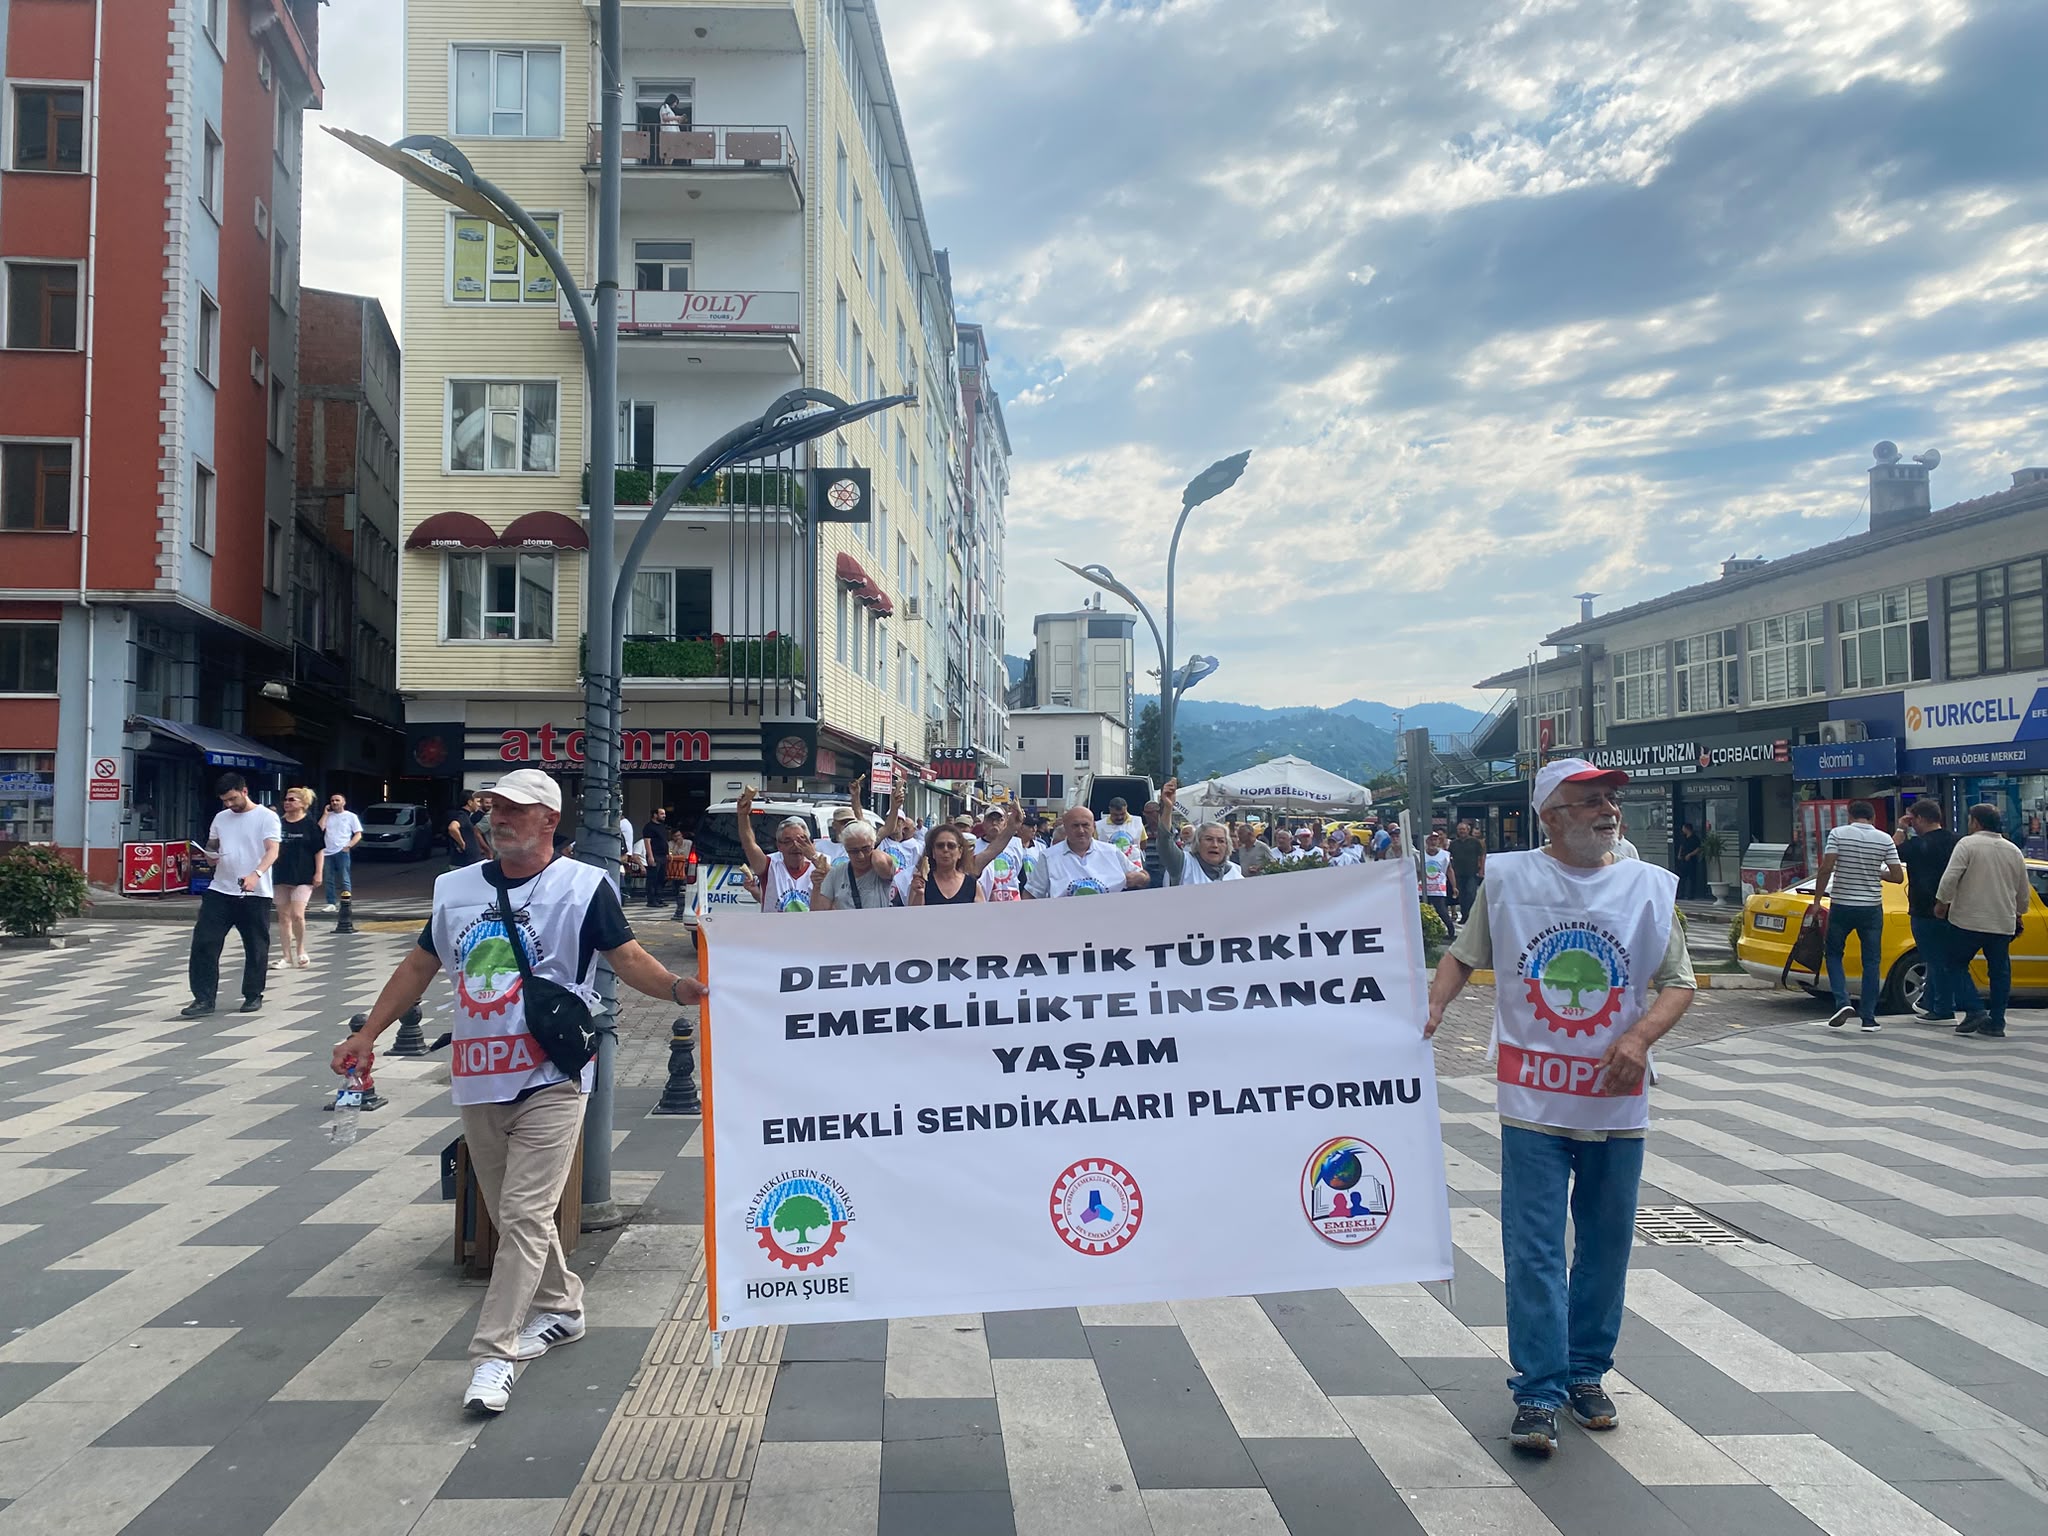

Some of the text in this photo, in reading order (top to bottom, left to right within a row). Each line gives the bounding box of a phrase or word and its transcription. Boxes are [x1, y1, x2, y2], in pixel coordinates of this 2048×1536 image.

[677, 293, 758, 321] JOLLY
[431, 538, 461, 546] atomm
[522, 538, 553, 546] atomm
[1924, 697, 2021, 728] TURKCELL
[564, 761, 584, 770] Foo
[620, 761, 638, 771] afé
[1588, 746, 1650, 768] KARABULUT
[1819, 750, 1854, 769] ekomini
[1932, 749, 2026, 766] FATURA ÖDEME MERKEZİ
[1240, 787, 1271, 796] HOPA
[707, 891, 739, 904] RAFİK
[1526, 921, 1599, 951] EMEKLİLERİN
[780, 922, 1384, 993] DEMOKRATİK TÜRKİYE
[478, 991, 496, 999] 2017
[785, 976, 1386, 1040] EMEKLİLİKTE İNSANCA
[1562, 1007, 1585, 1016] 2017
[459, 1039, 534, 1073] HOPA
[992, 1037, 1179, 1079] YAŞAM
[762, 1077, 1422, 1145] EMEKLİ SENDİKALARI PLATFORMU
[745, 1168, 856, 1232] TÜM EMEKLİLERİN SENDİKASI
[1324, 1217, 1376, 1229] EMEKLİ
[746, 1277, 849, 1300] HOPA ŞUBE
